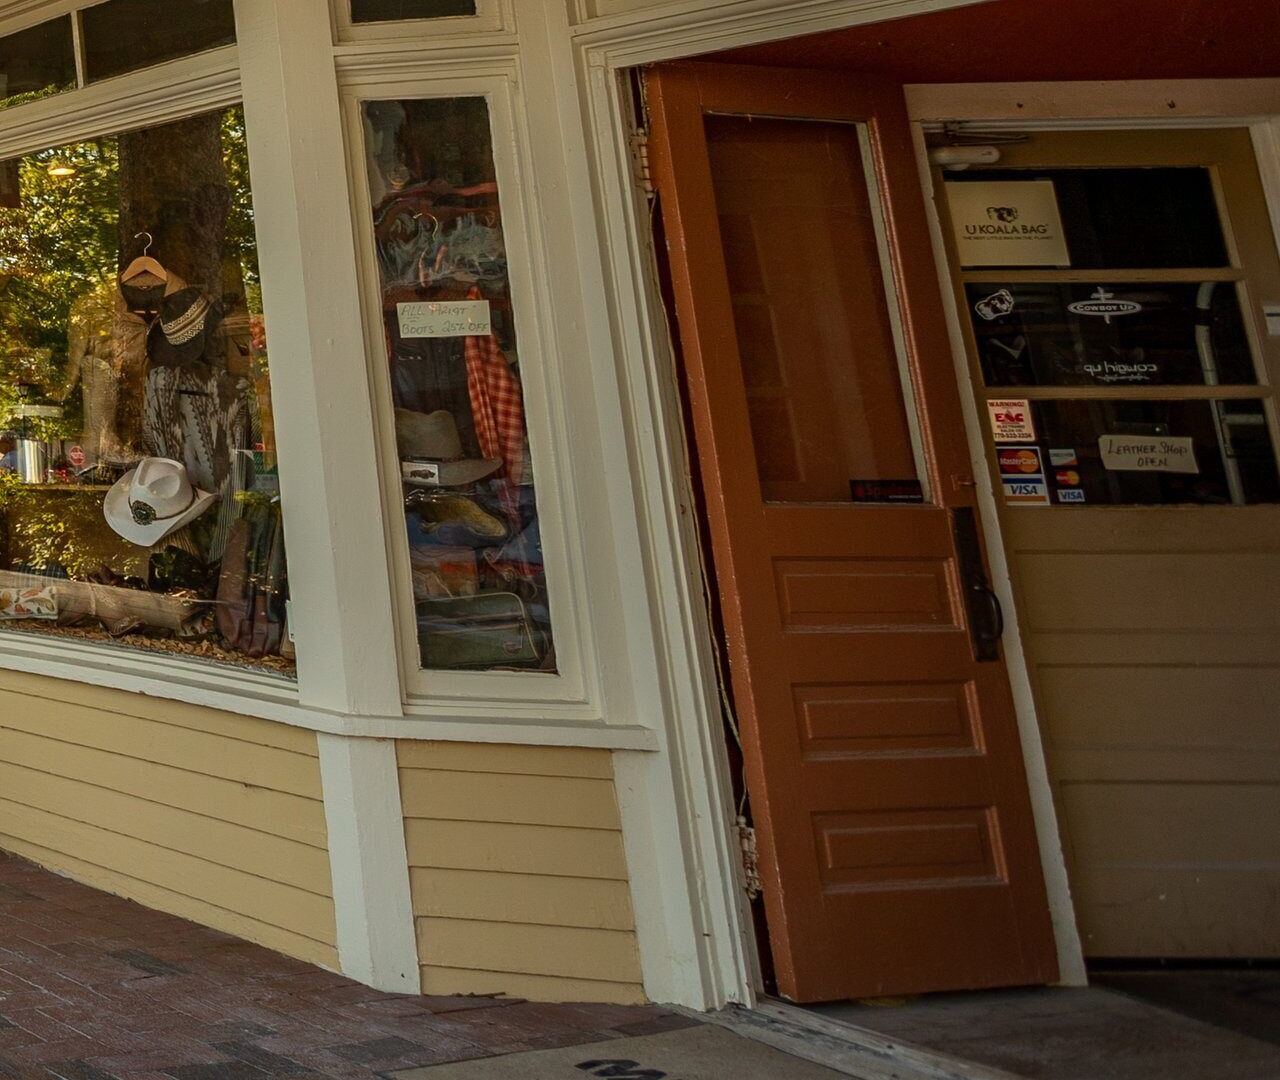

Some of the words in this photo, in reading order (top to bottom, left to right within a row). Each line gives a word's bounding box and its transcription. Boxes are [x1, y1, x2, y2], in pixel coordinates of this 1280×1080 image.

[965, 225, 976, 235] U
[979, 224, 1019, 235] KOALA
[1022, 224, 1047, 234] BAG
[402, 324, 434, 335] BOOTS
[468, 322, 489, 332] OFF
[999, 457, 1038, 465] MasterCard
[1137, 457, 1169, 467] OPEN
[1010, 485, 1038, 494] VISA
[1061, 491, 1083, 500] VISA
